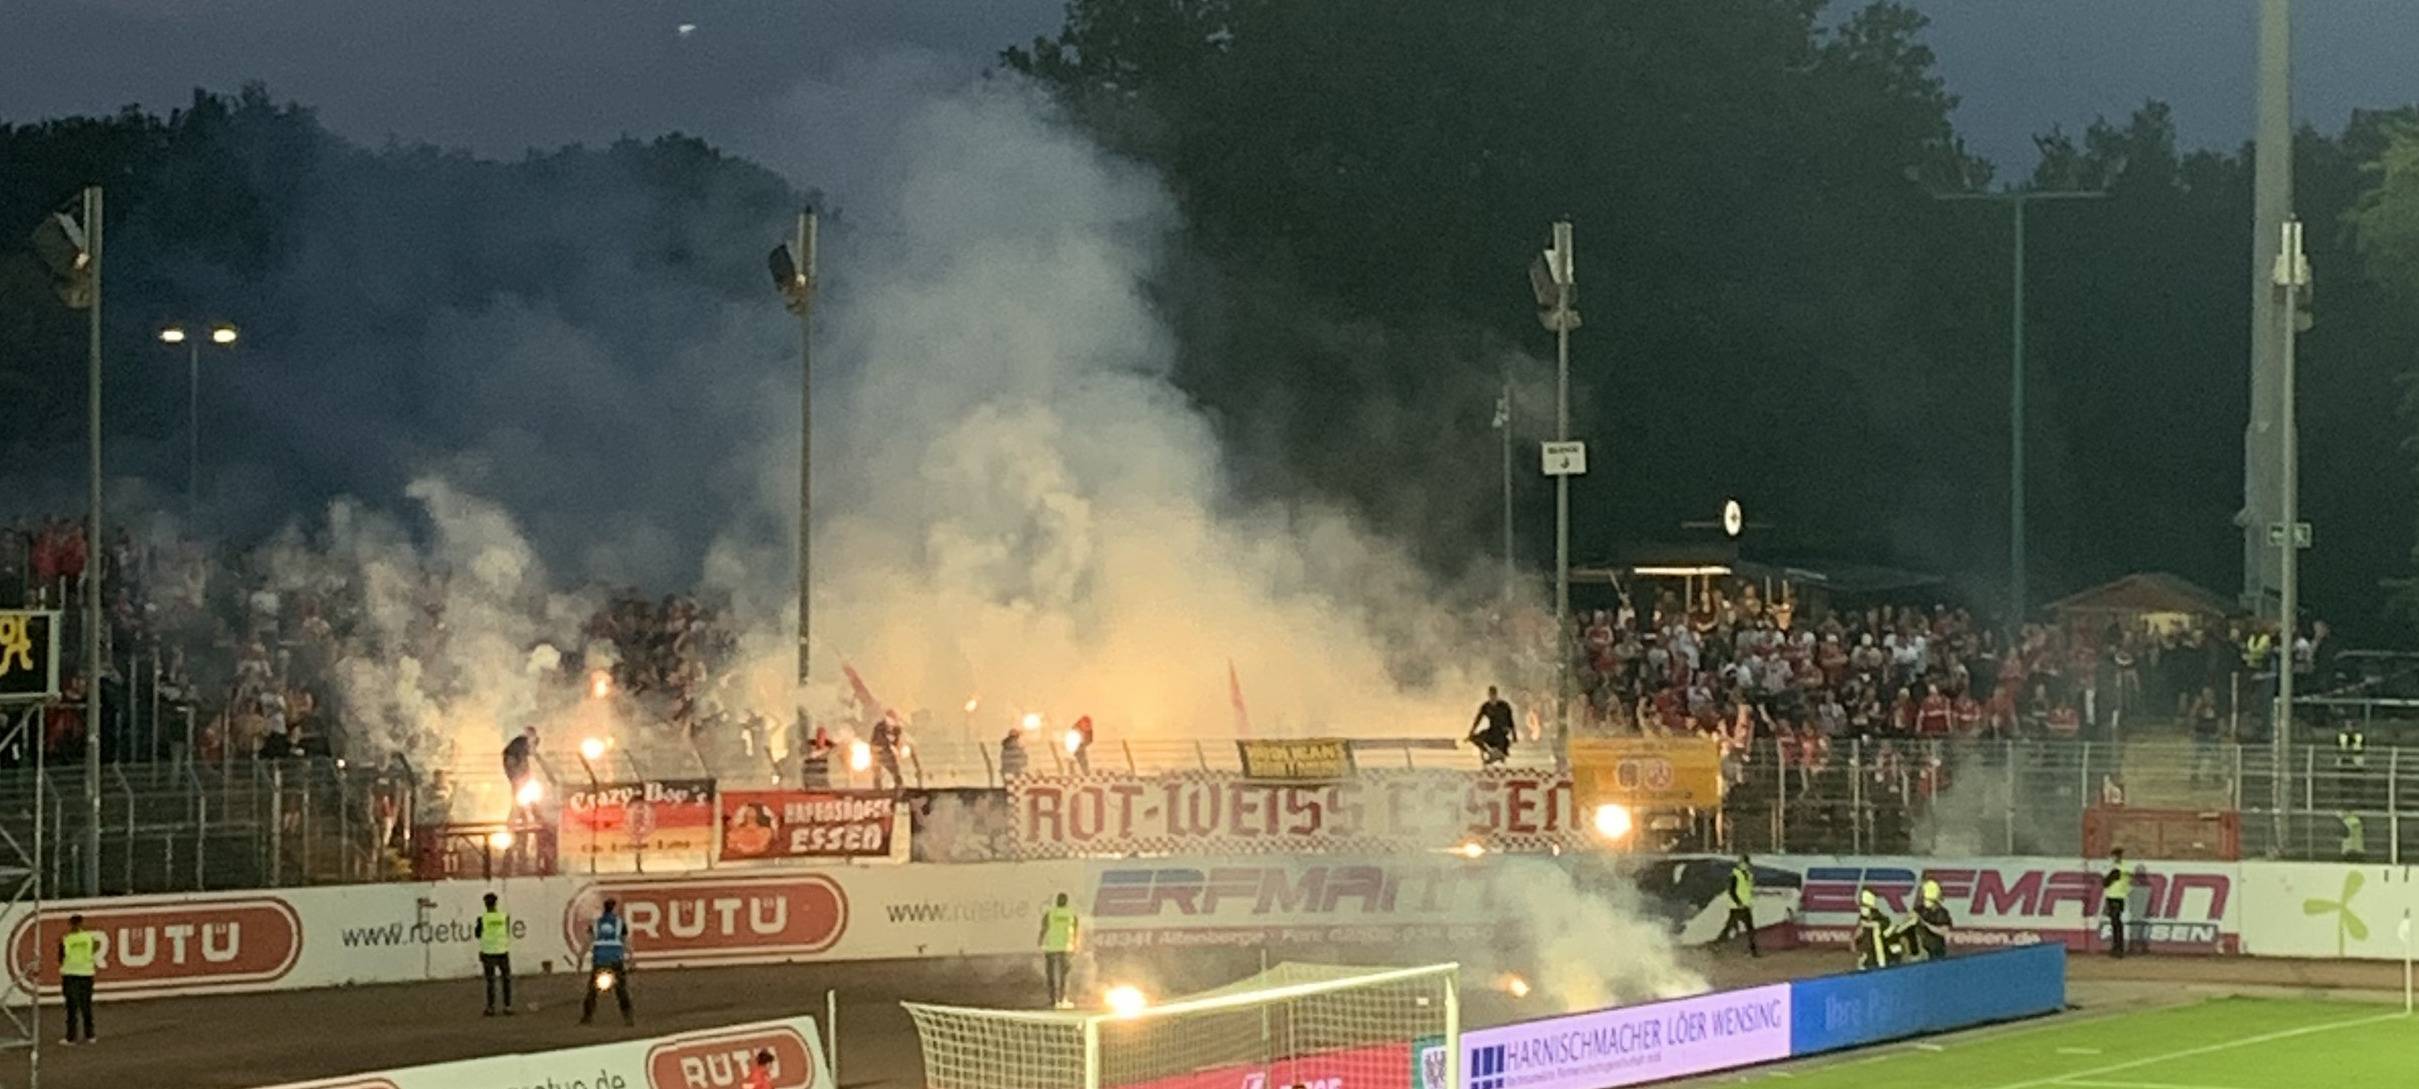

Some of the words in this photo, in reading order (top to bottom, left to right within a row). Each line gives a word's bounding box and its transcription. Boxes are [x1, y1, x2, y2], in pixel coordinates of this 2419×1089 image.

[790, 823, 882, 853] ESSEN
[1025, 781, 1363, 842] ROT-WEISS
[1506, 1018, 1662, 1070] HARNISCHMACHER
[1712, 998, 1782, 1038] WENSING
